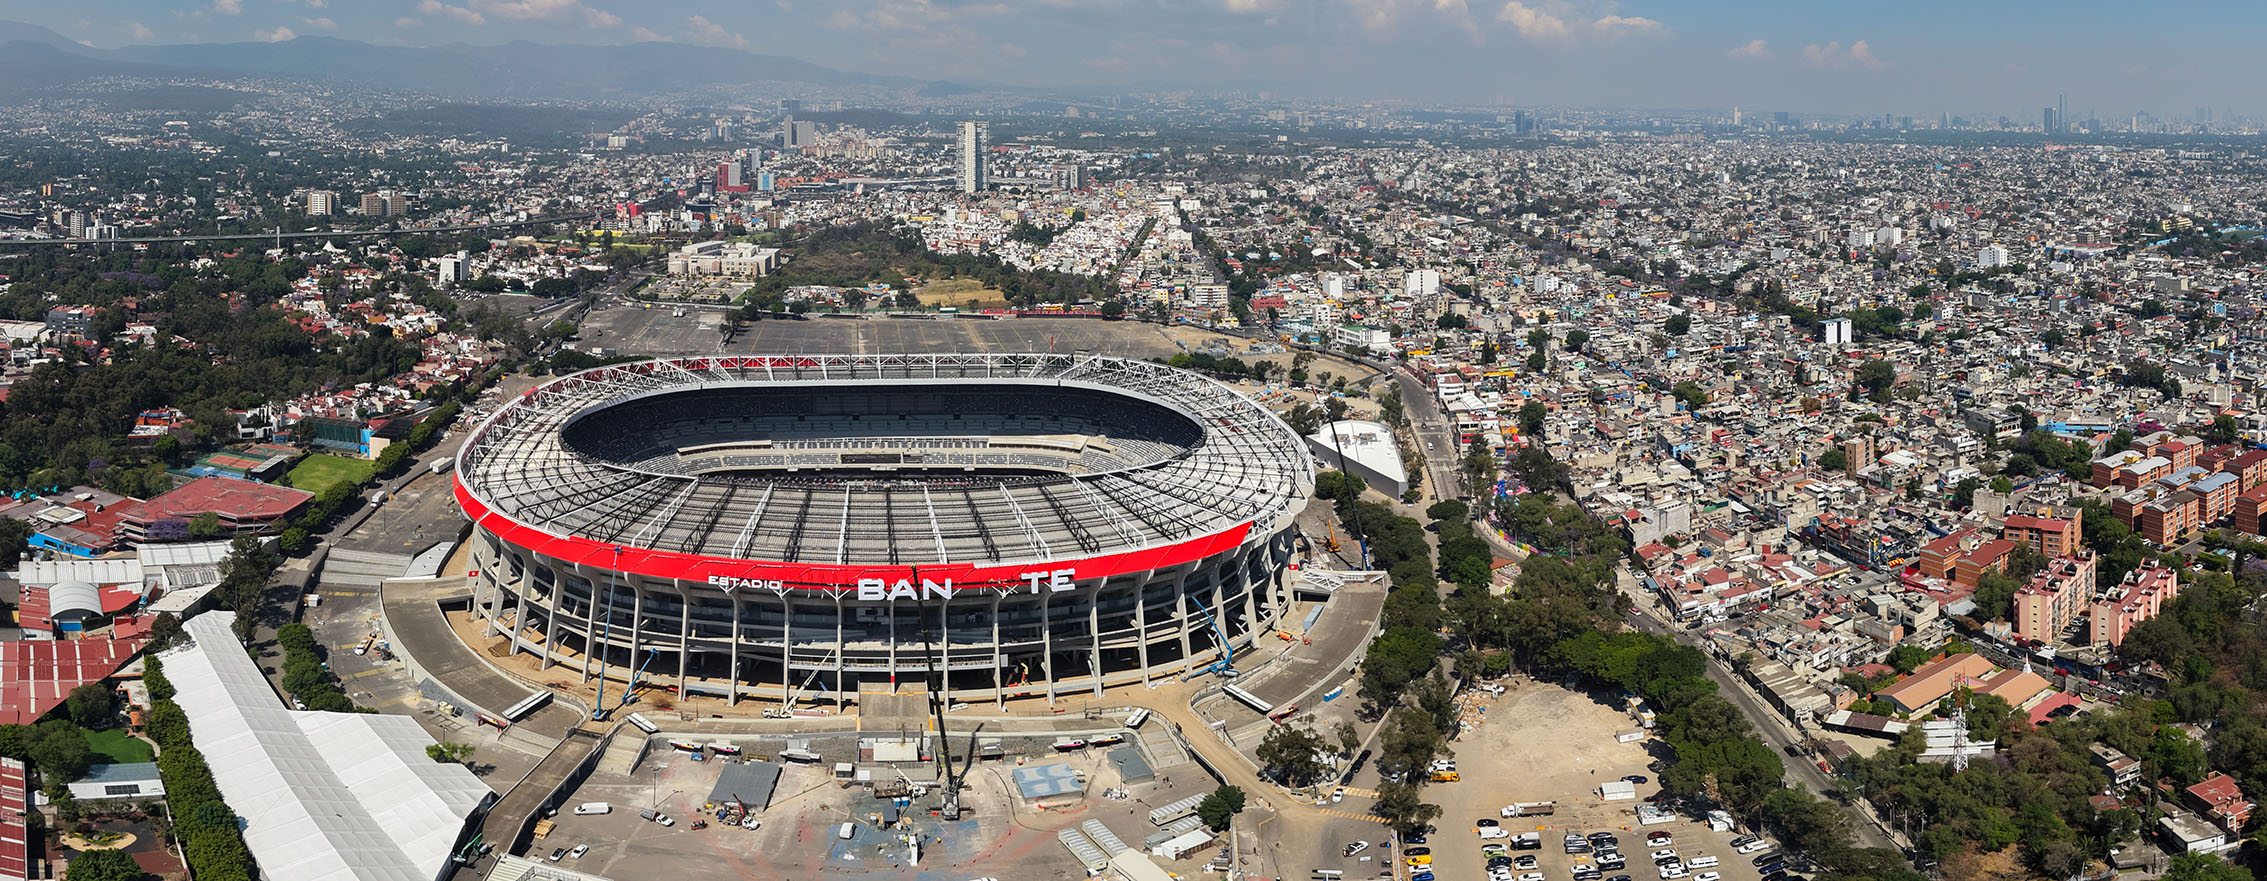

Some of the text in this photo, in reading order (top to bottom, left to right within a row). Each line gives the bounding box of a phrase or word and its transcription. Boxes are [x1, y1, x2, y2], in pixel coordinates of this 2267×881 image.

[708, 568, 1076, 601] ESTADIO BAN TE
